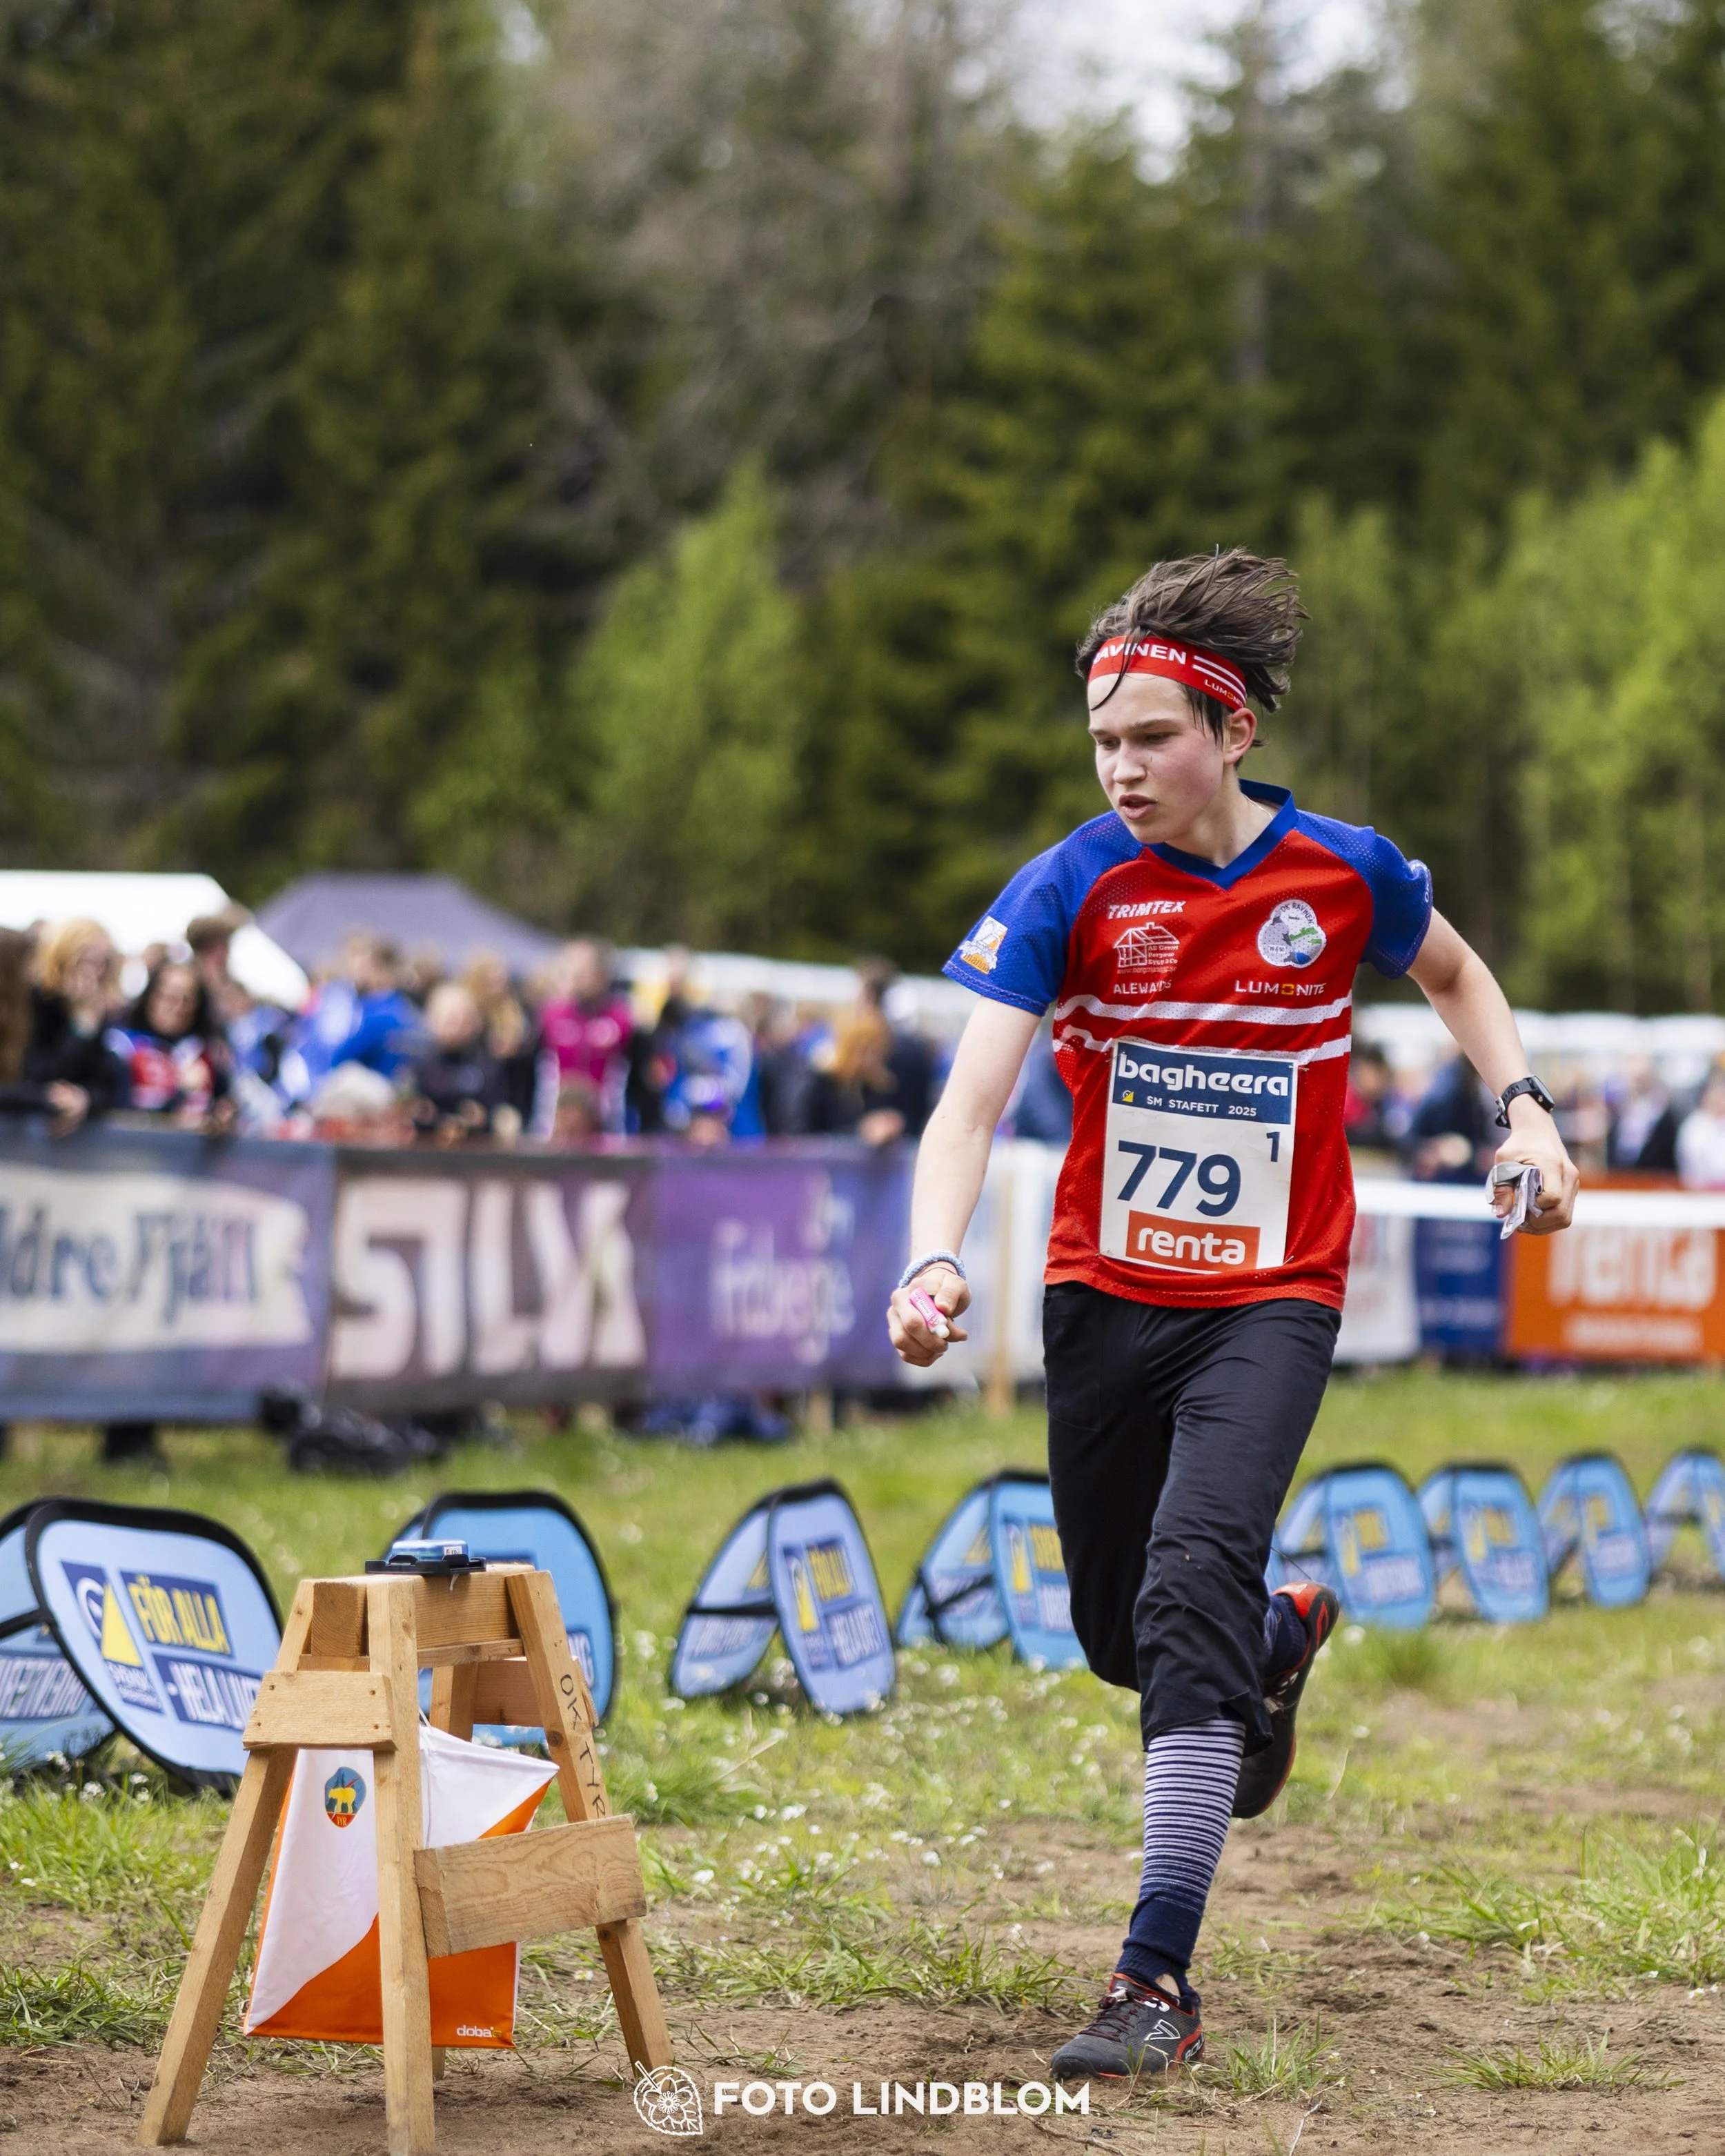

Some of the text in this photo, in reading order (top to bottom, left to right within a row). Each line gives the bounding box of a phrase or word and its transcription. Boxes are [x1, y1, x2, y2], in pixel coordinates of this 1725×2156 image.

[1107, 900, 1186, 920] TRIMTEX
[1292, 902, 1314, 924] RAVINEN
[1235, 980, 1326, 996] LUMONITE
[1118, 1051, 1289, 1096] bagheera
[1147, 1096, 1257, 1117] SM STAFETT 2025
[1266, 1131, 1280, 1163] 1
[1117, 1140, 1241, 1217] 779
[1137, 1227, 1246, 1265] renta
[127, 1574, 232, 1654] FÖR ALLA
[336, 1816, 347, 1826] TYR
